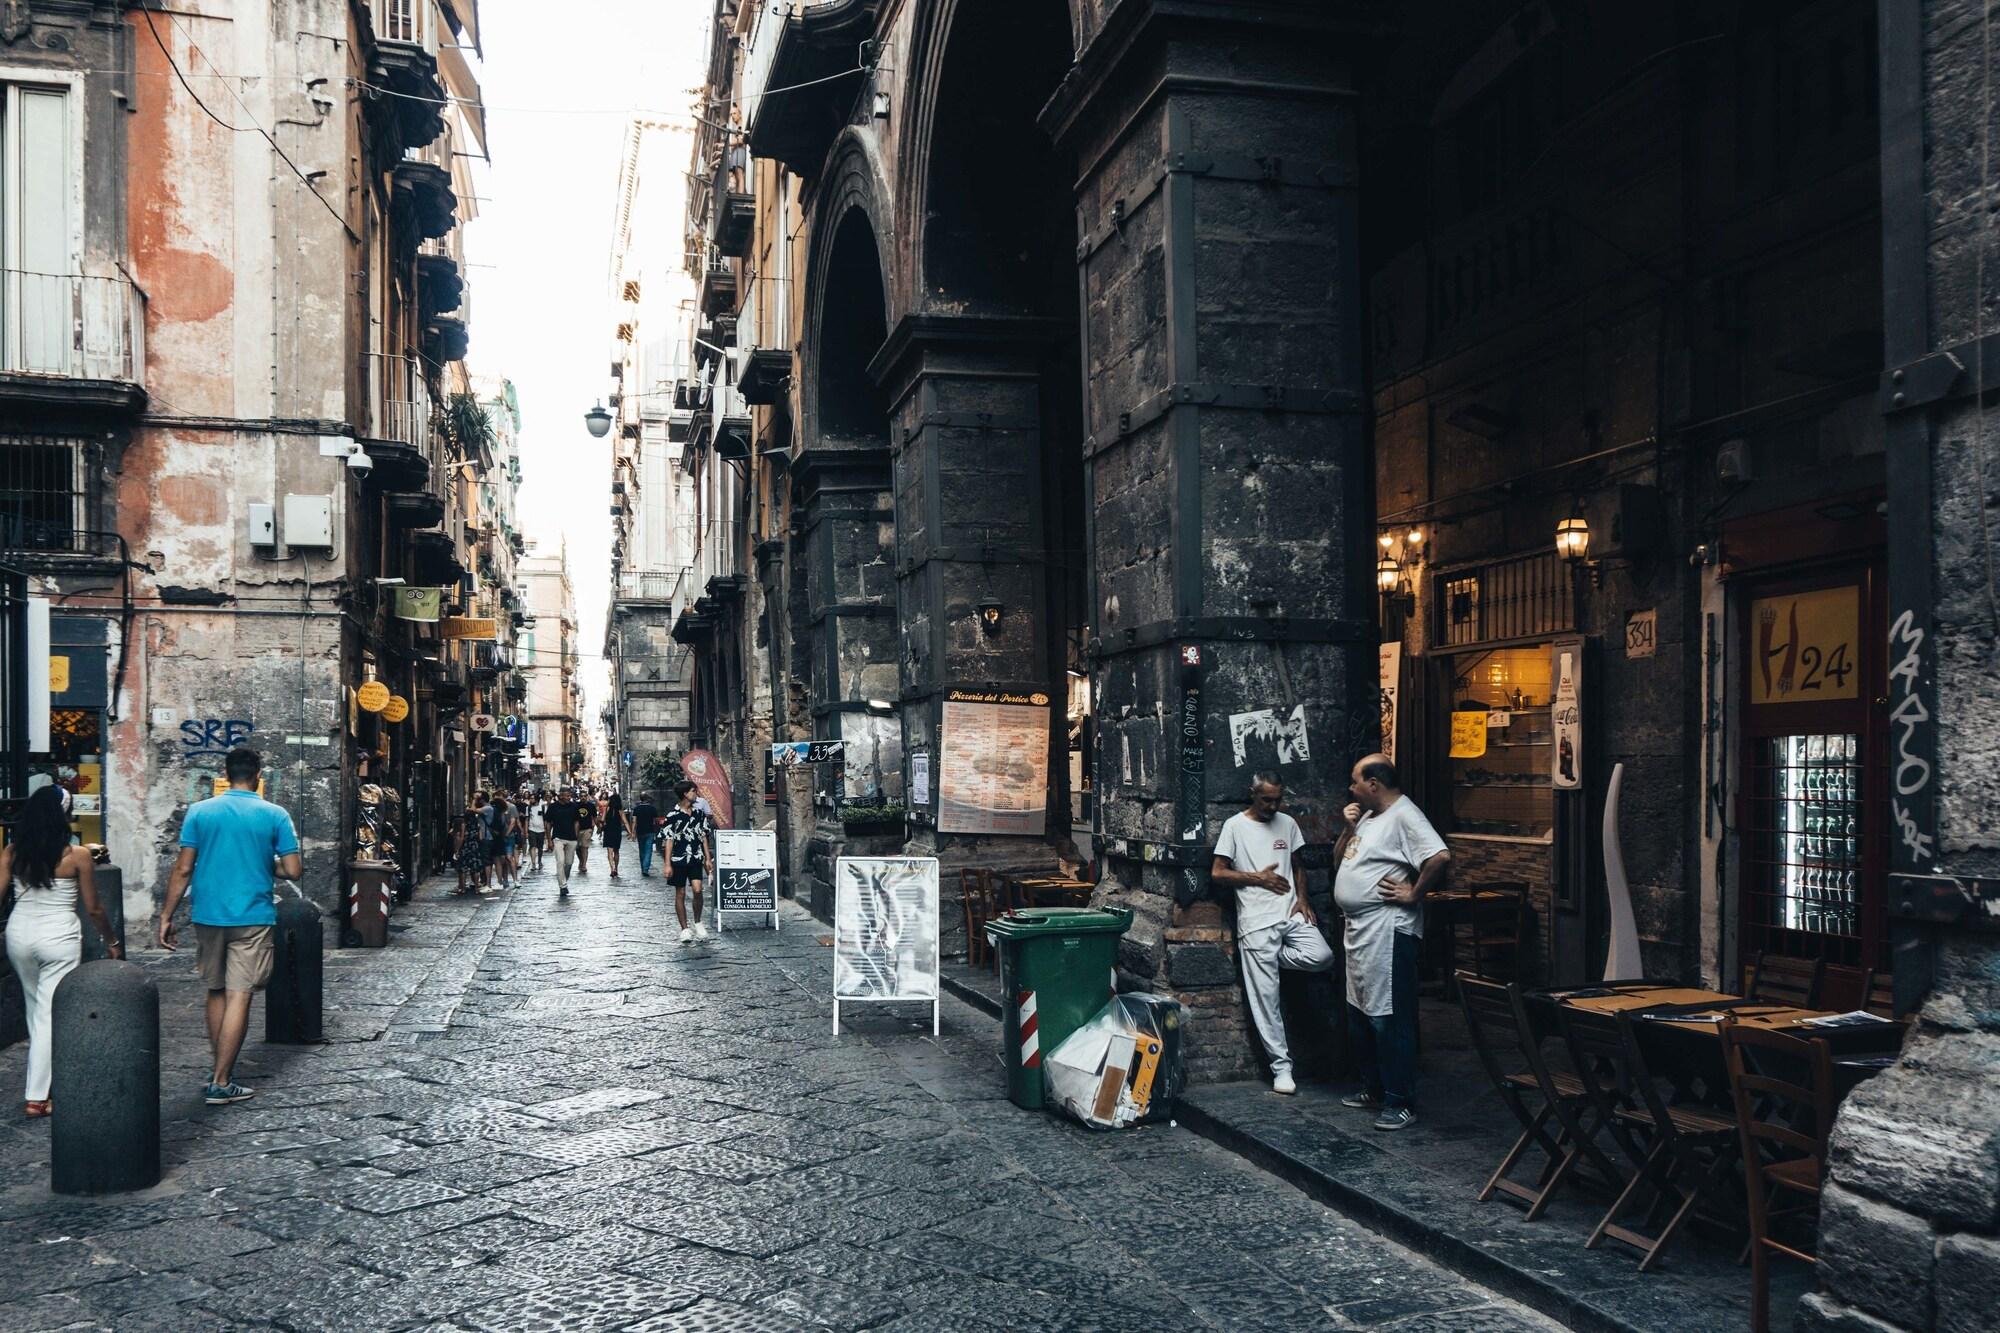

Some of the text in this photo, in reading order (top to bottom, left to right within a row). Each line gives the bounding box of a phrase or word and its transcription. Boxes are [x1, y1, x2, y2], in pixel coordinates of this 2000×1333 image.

[949, 690, 1029, 703] Pizzeria del Portico
[809, 745, 828, 761] 33
[722, 872, 748, 890] 33
